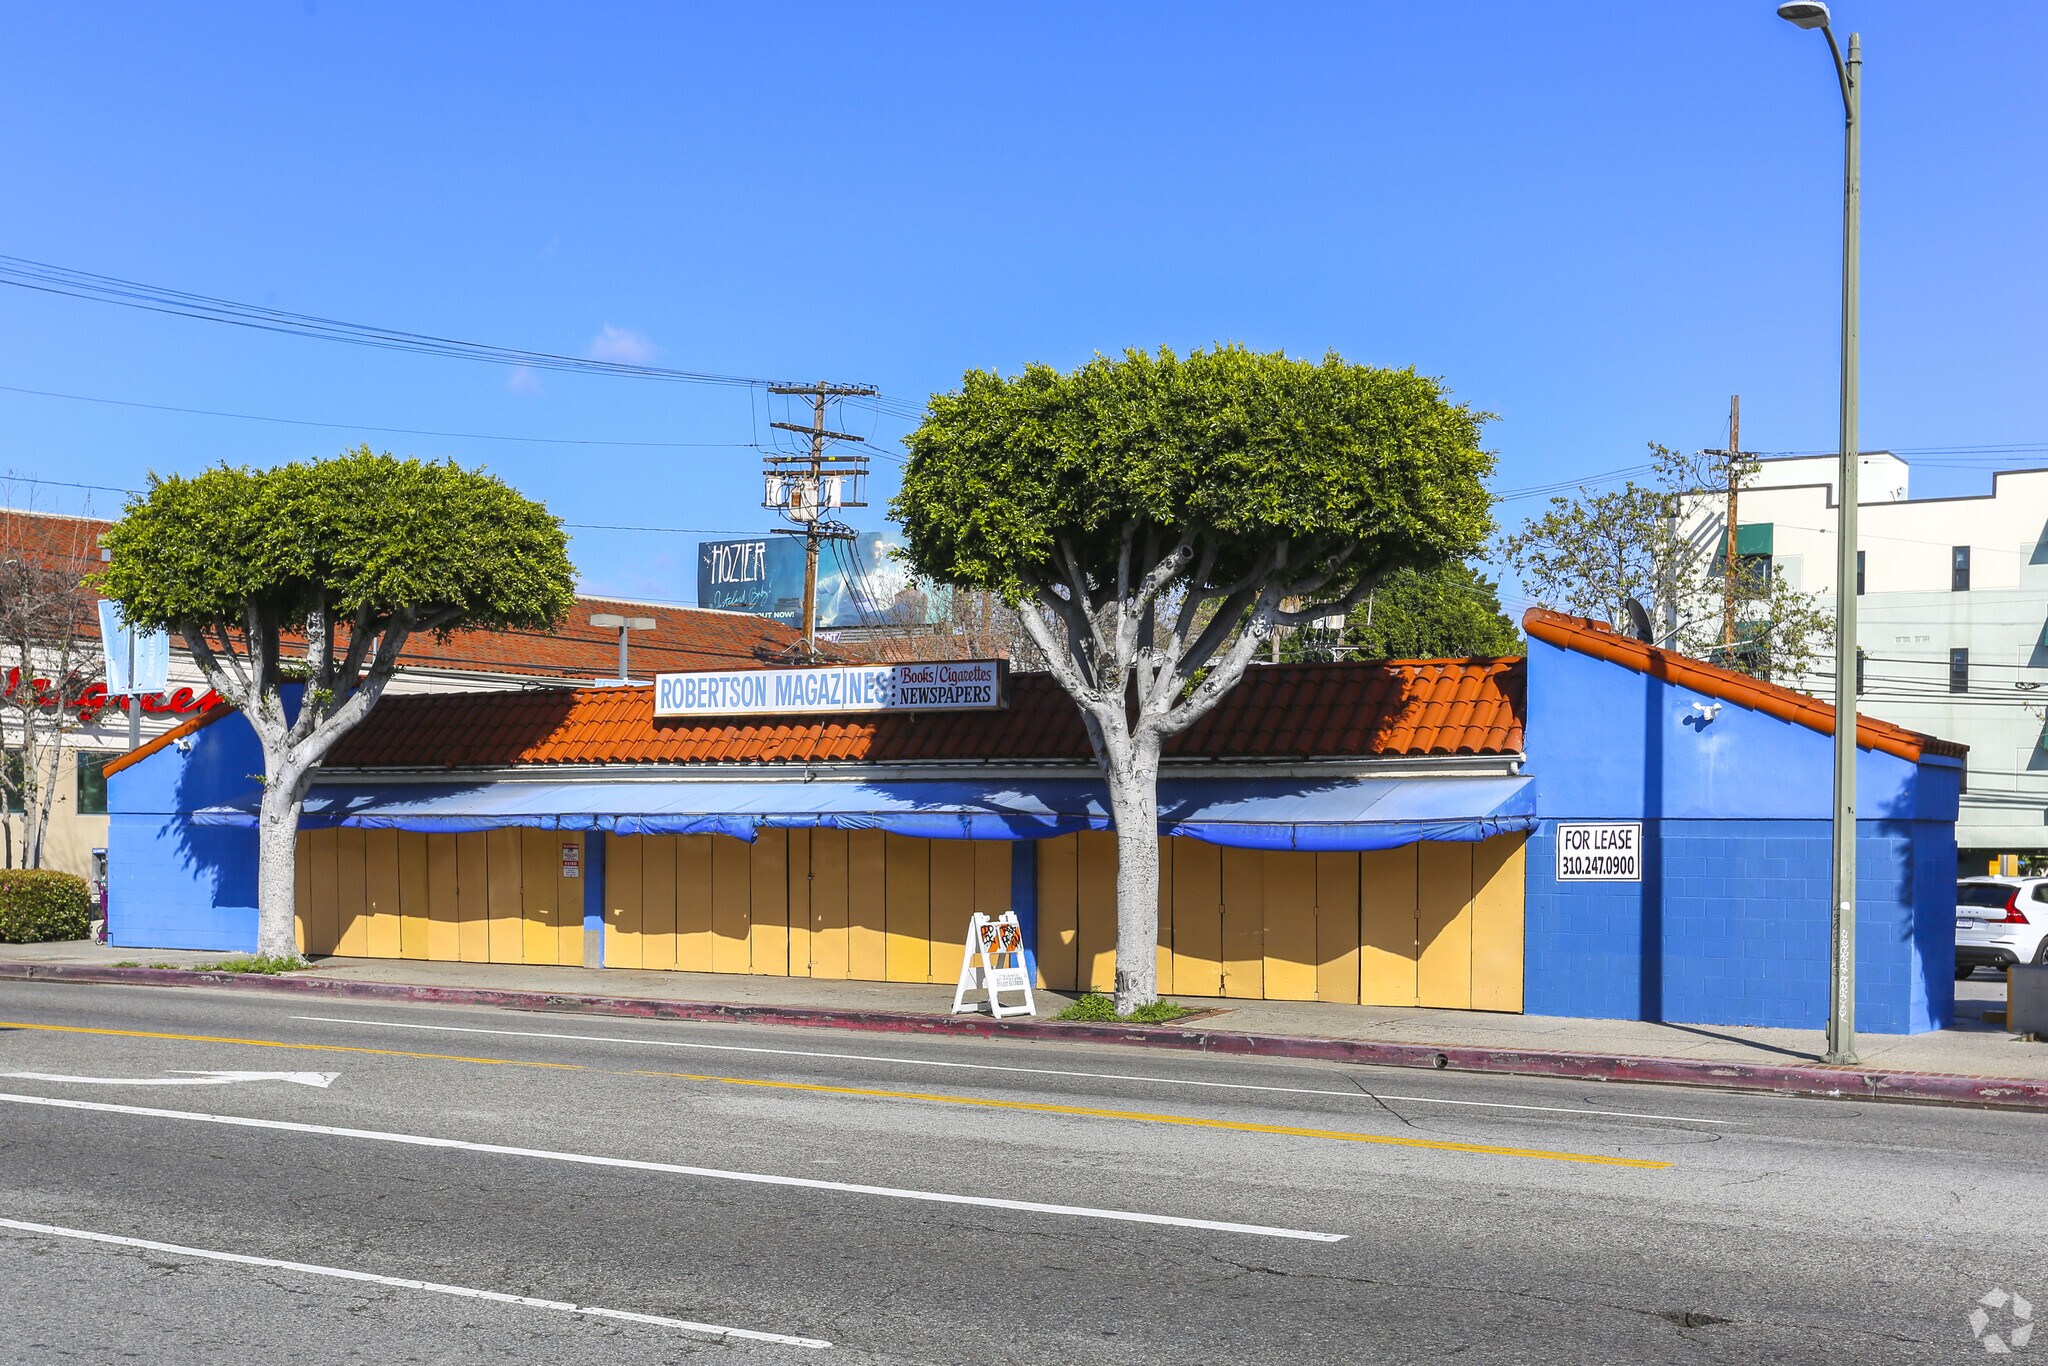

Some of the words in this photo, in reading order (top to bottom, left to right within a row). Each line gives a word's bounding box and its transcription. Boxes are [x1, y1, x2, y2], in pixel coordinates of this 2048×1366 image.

[710, 542, 766, 584] HOZIER
[146, 636, 156, 677] armacy
[901, 665, 992, 686] Books/Cigarettes
[660, 675, 767, 709] ROBERTSON
[775, 671, 888, 706] MAGAZINES
[900, 686, 991, 704] NEWSPAPERS
[1565, 829, 1590, 850] FOR
[1594, 829, 1632, 850] LEASE
[1563, 856, 1634, 875] 310.247.0900
